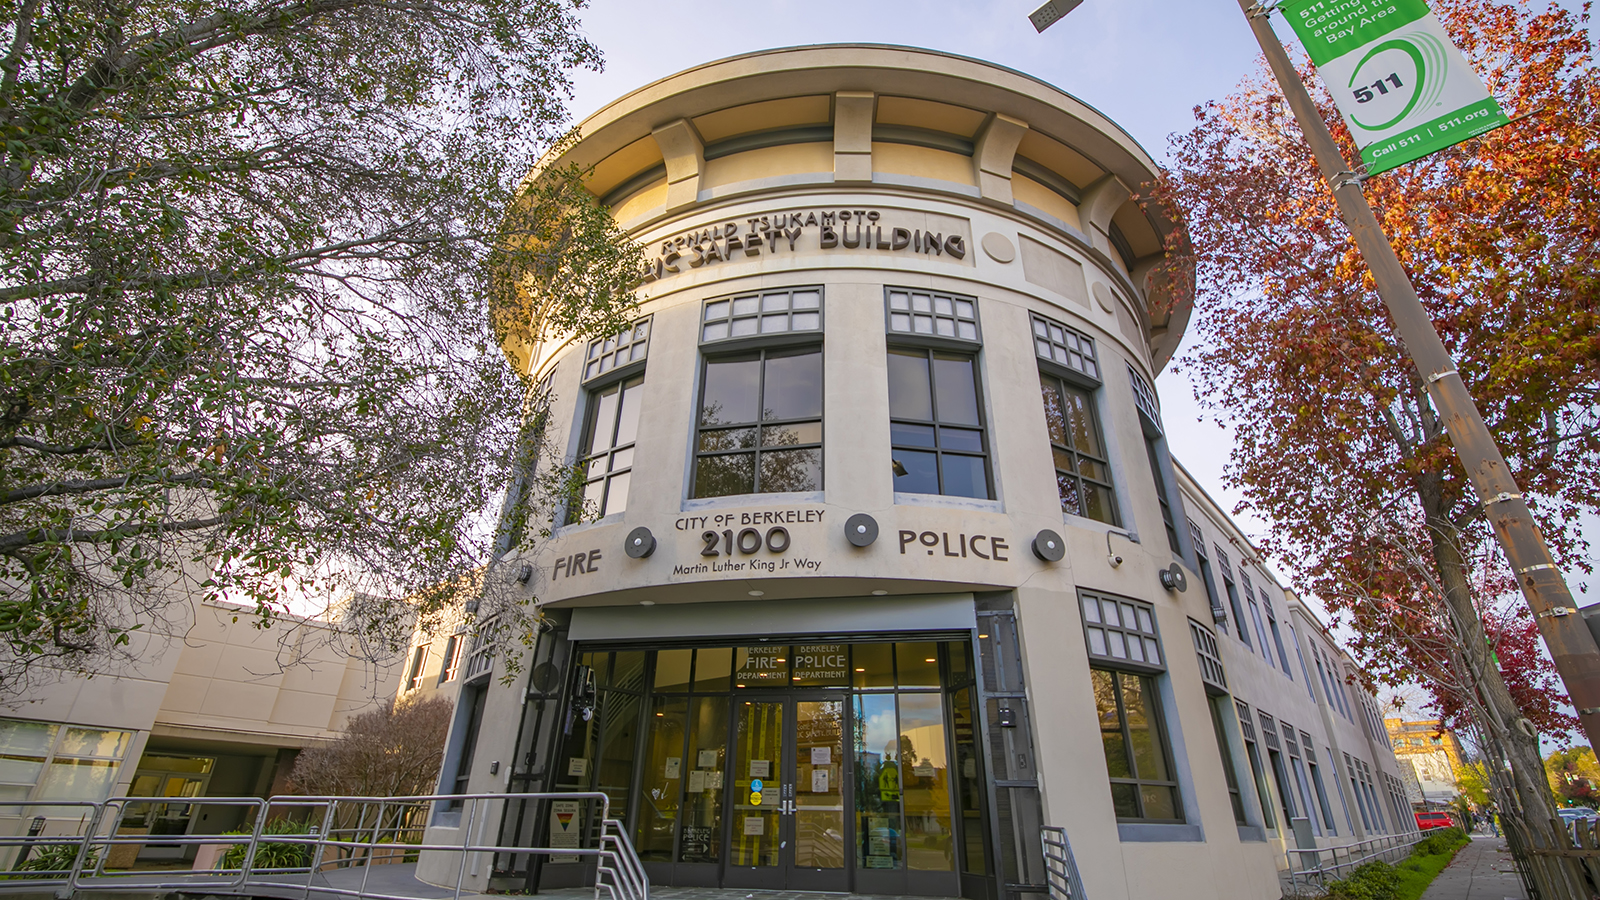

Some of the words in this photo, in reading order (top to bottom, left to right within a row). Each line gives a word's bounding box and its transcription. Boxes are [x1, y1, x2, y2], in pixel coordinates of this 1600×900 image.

[1299, 1, 1325, 19] 511
[1305, 0, 1361, 28] Getting
[1313, 4, 1368, 37] around
[1326, 25, 1354, 44] Bay
[1360, 5, 1397, 28] Area
[1352, 72, 1404, 104] 511
[1372, 142, 1397, 158] Call
[1398, 133, 1421, 148] 511
[1438, 108, 1489, 132] 511.org
[661, 222, 738, 255] RONALD
[747, 209, 881, 233] TSUKAMOTO
[688, 227, 802, 269] SAFETY
[820, 225, 966, 260] BUILDING
[675, 516, 709, 531] CITY
[715, 514, 736, 527] OF
[741, 510, 825, 526] BERKELEY
[700, 526, 791, 557] 2100
[898, 530, 1009, 562] POLICE
[552, 548, 602, 581] FIRE
[673, 563, 708, 576] Martin
[712, 560, 745, 573] Luther
[749, 559, 775, 573] King
[779, 558, 791, 570] Jr
[793, 558, 822, 572] Way
[746, 656, 778, 669] FIRE
[795, 655, 846, 668] POLICE
[800, 645, 840, 654] BERKELEY
[795, 670, 846, 679] DEPARTMENT
